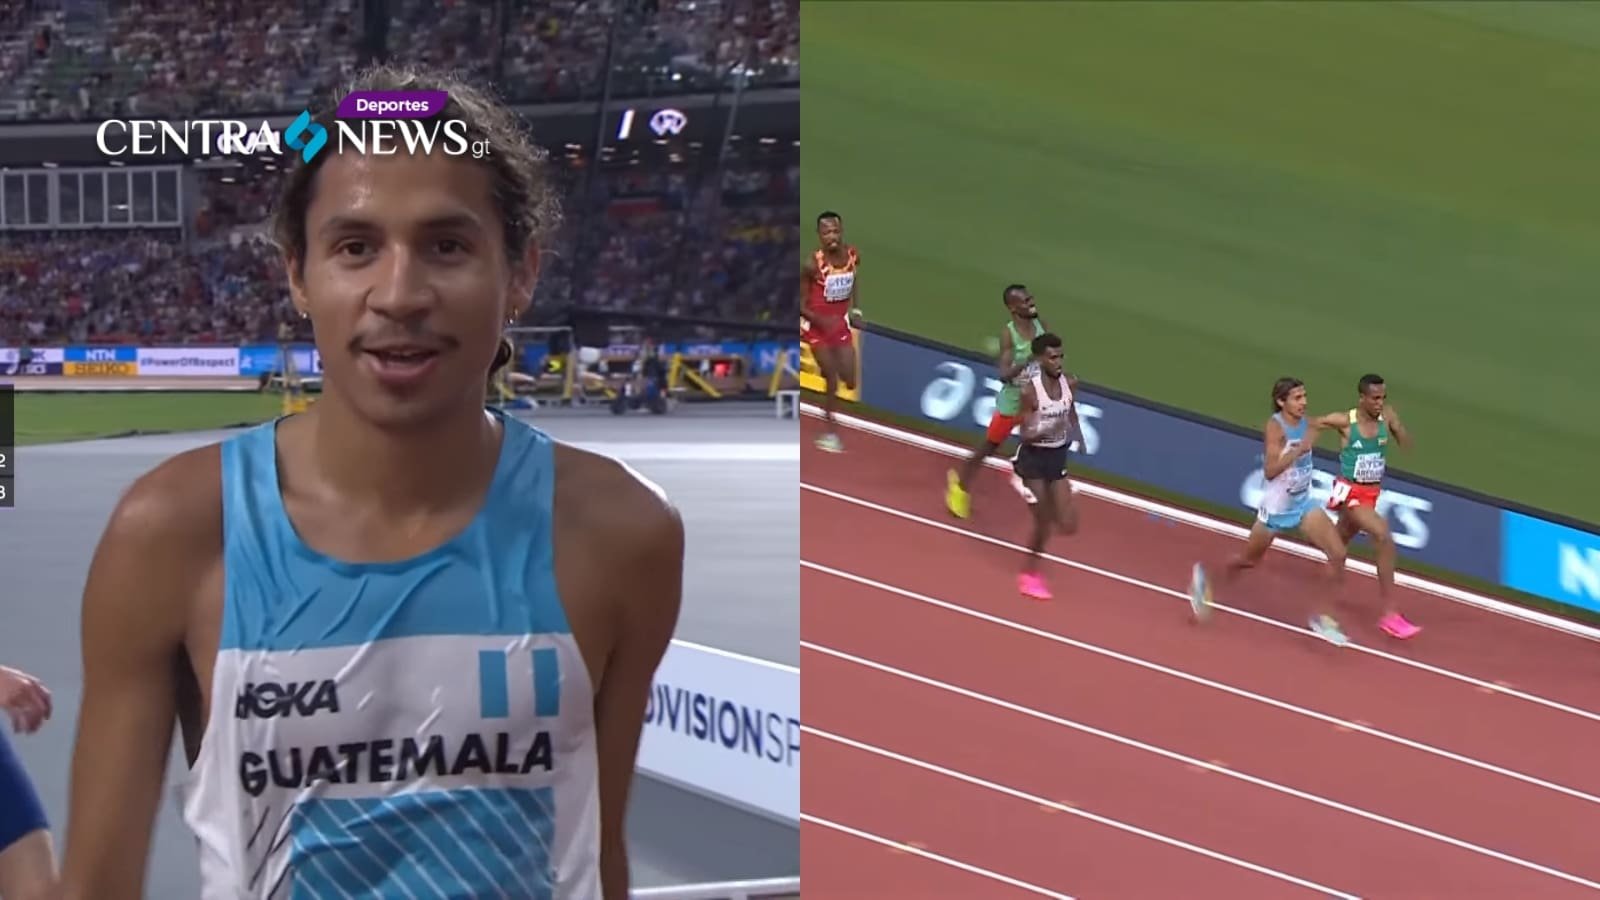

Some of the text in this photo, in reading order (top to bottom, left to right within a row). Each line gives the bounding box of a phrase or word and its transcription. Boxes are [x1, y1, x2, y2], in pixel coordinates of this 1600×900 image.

[86, 349, 115, 361] NTN
[140, 356, 235, 367] #PowerOfRespect
[75, 363, 131, 375] SEIKO
[239, 731, 553, 797] GUATEMALA
